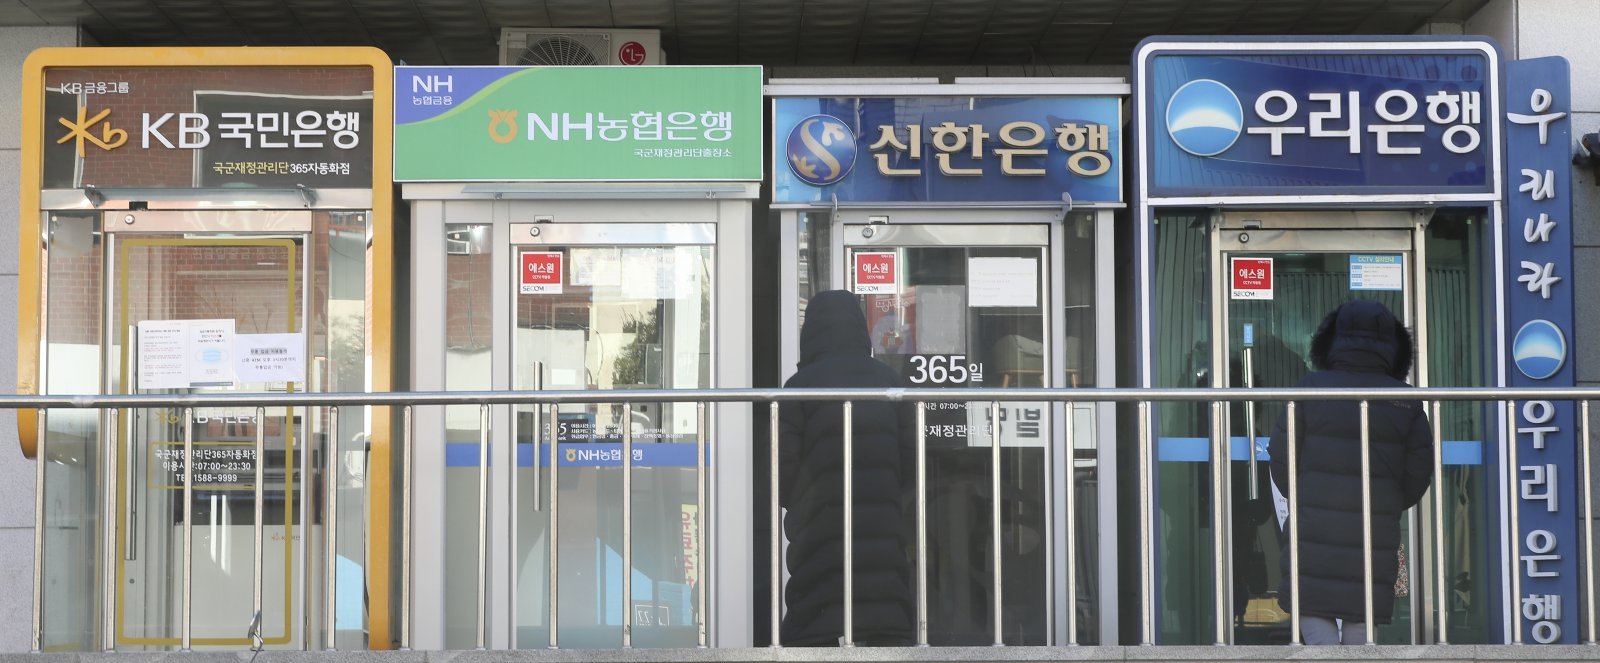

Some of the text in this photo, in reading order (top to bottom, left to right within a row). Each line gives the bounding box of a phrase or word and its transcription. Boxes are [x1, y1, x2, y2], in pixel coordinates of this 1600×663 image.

[412, 75, 453, 93] NH
[412, 95, 453, 106] 농협금융
[526, 110, 733, 142] NH농협은행
[1247, 89, 1482, 157] 우리은행
[869, 121, 1113, 177] 신한은행
[528, 262, 555, 274] 에스원
[862, 262, 889, 274] 에스원
[1239, 268, 1266, 280] 에스원
[544, 422, 567, 437] 35
[578, 448, 643, 461] NH농협행
